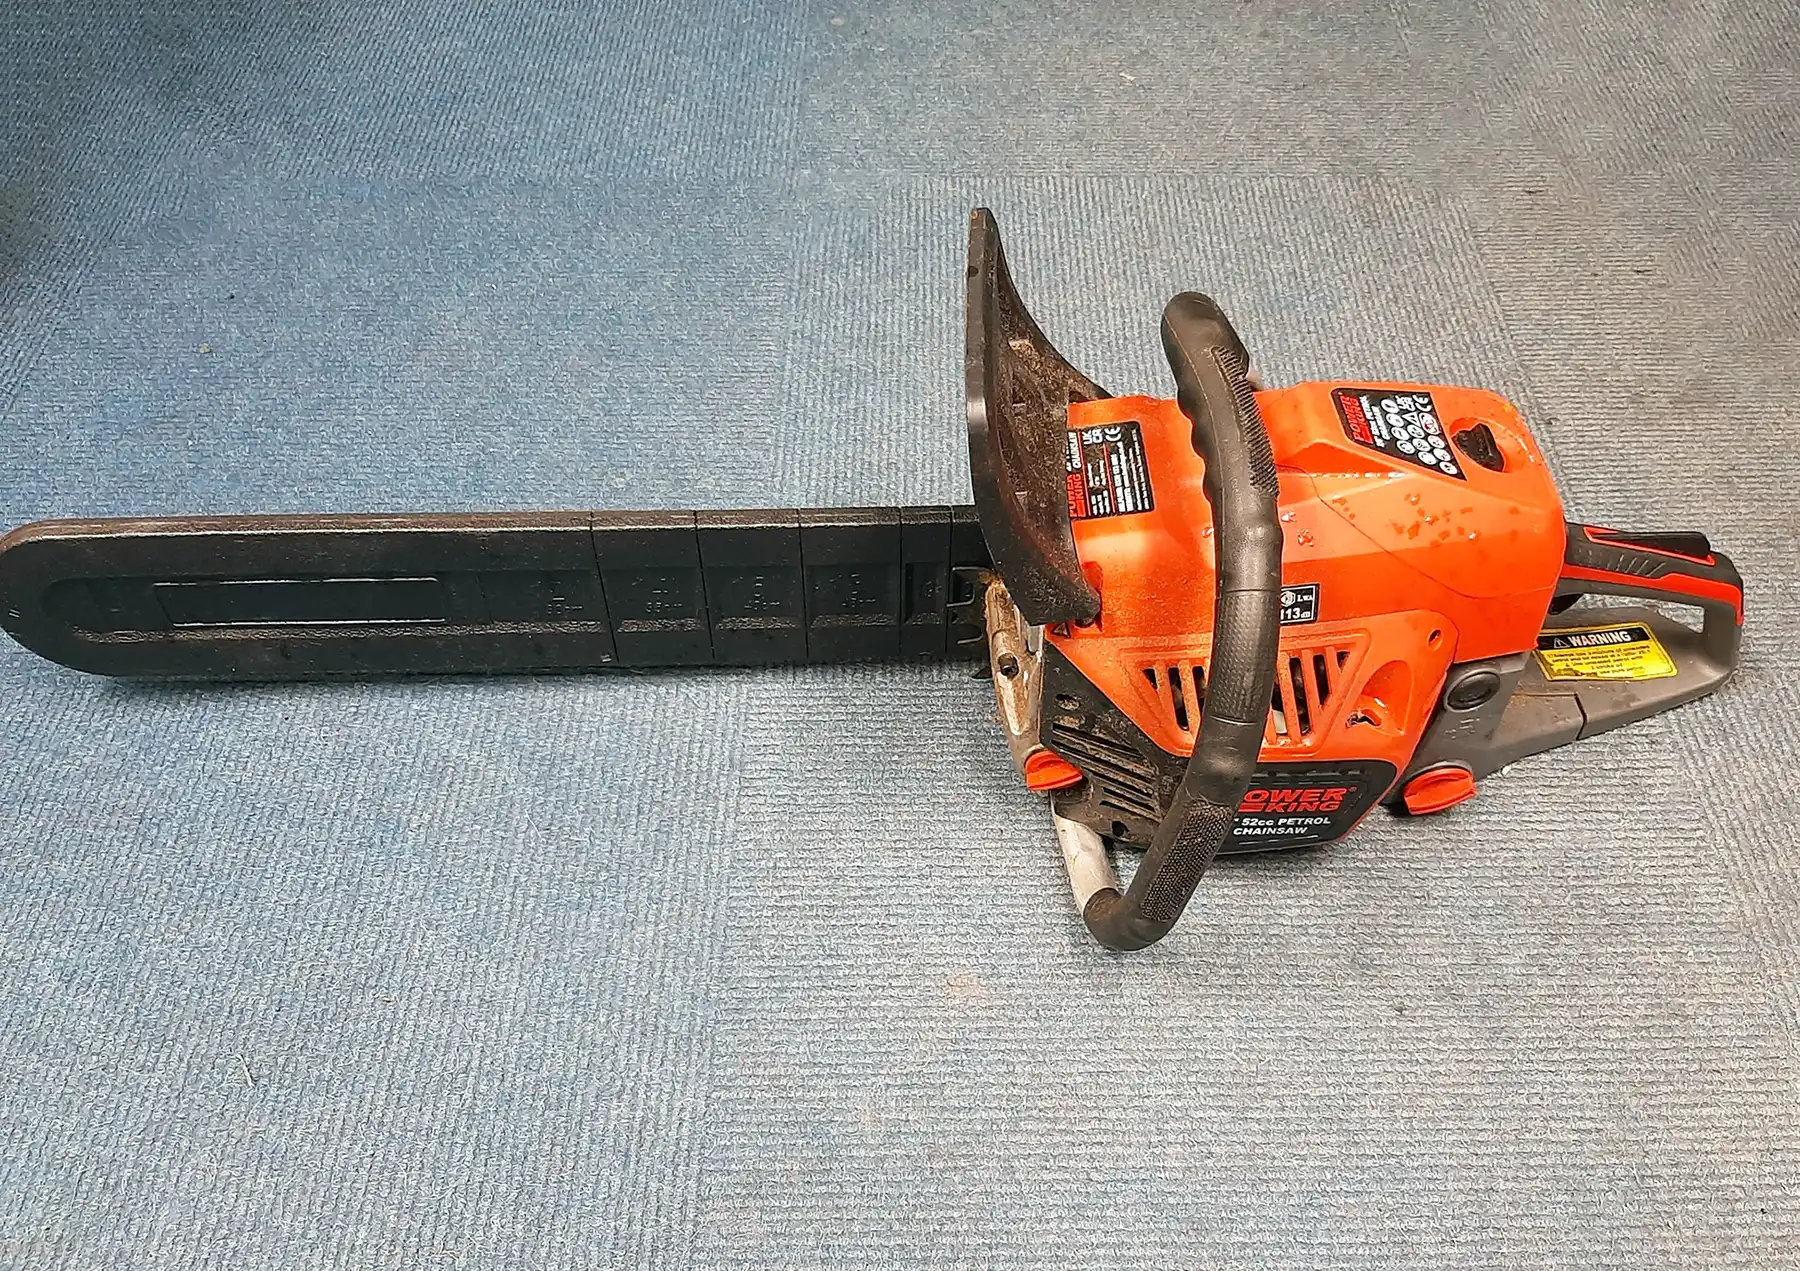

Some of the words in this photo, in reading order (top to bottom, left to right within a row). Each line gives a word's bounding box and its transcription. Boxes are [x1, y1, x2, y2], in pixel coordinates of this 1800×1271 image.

[1340, 395, 1364, 441] POWER
[1082, 429, 1093, 445] UK
[1073, 473, 1084, 500] KING
[1567, 631, 1631, 647] WARNING
[1243, 787, 1348, 802] OWER
[1265, 802, 1341, 813] KING
[1241, 818, 1274, 827] 52cc
[1277, 817, 1331, 826] PETROL
[1233, 827, 1308, 836] CHAINSAW
